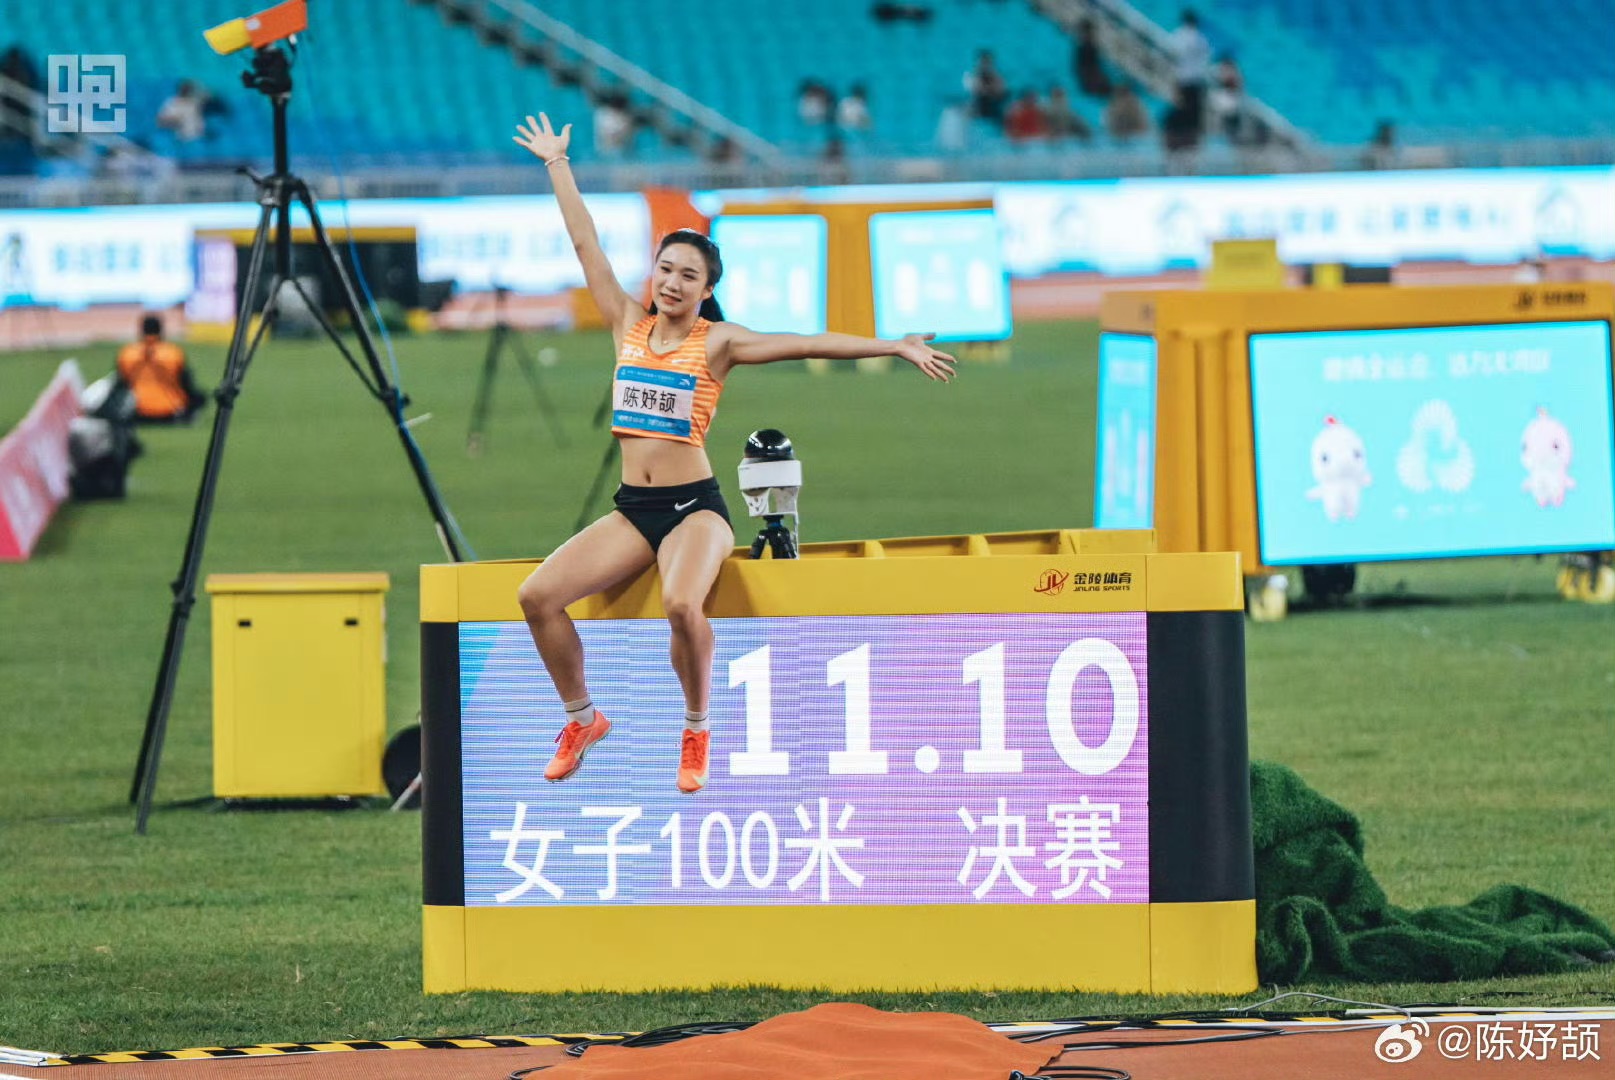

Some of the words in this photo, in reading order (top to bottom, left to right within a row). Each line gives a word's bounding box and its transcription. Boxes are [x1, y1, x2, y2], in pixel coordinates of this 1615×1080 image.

[623, 386, 676, 414] 陈妤颉
[1073, 572, 1132, 585] 金陵体育
[728, 637, 1140, 776] 11.10
[490, 797, 865, 903] 女子100米
[956, 795, 1124, 901] 决赛
